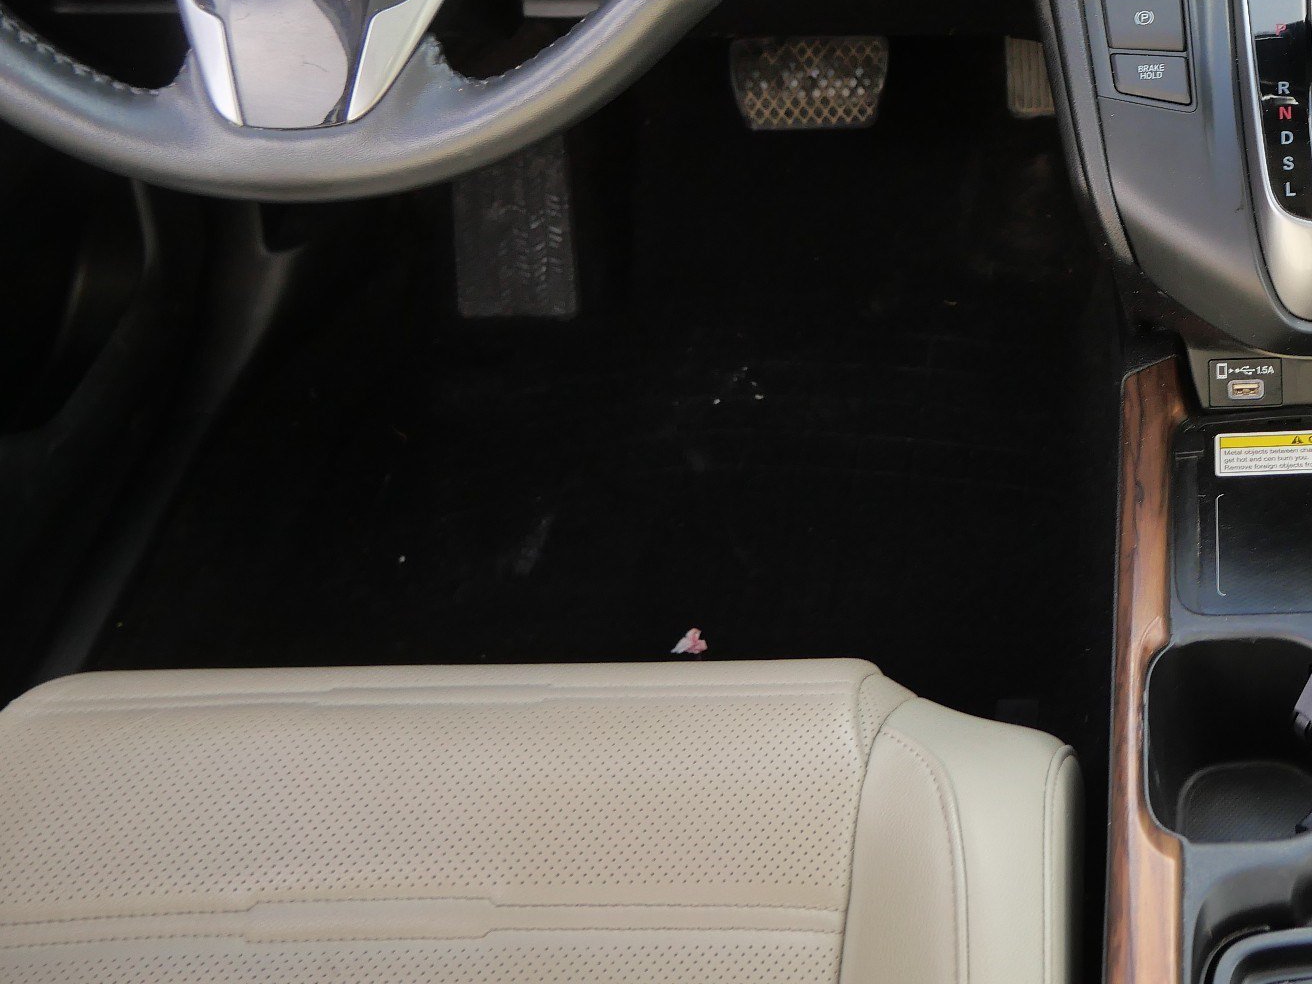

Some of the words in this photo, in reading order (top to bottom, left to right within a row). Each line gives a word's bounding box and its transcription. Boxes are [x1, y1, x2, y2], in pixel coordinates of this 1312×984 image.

[1275, 23, 1287, 36] P
[1137, 63, 1165, 73] BRAKE
[1140, 71, 1163, 80] HOLD
[1277, 81, 1290, 95] R
[1279, 106, 1292, 120] N
[1281, 130, 1294, 145] D
[1282, 156, 1295, 171] S
[1285, 181, 1297, 197] L
